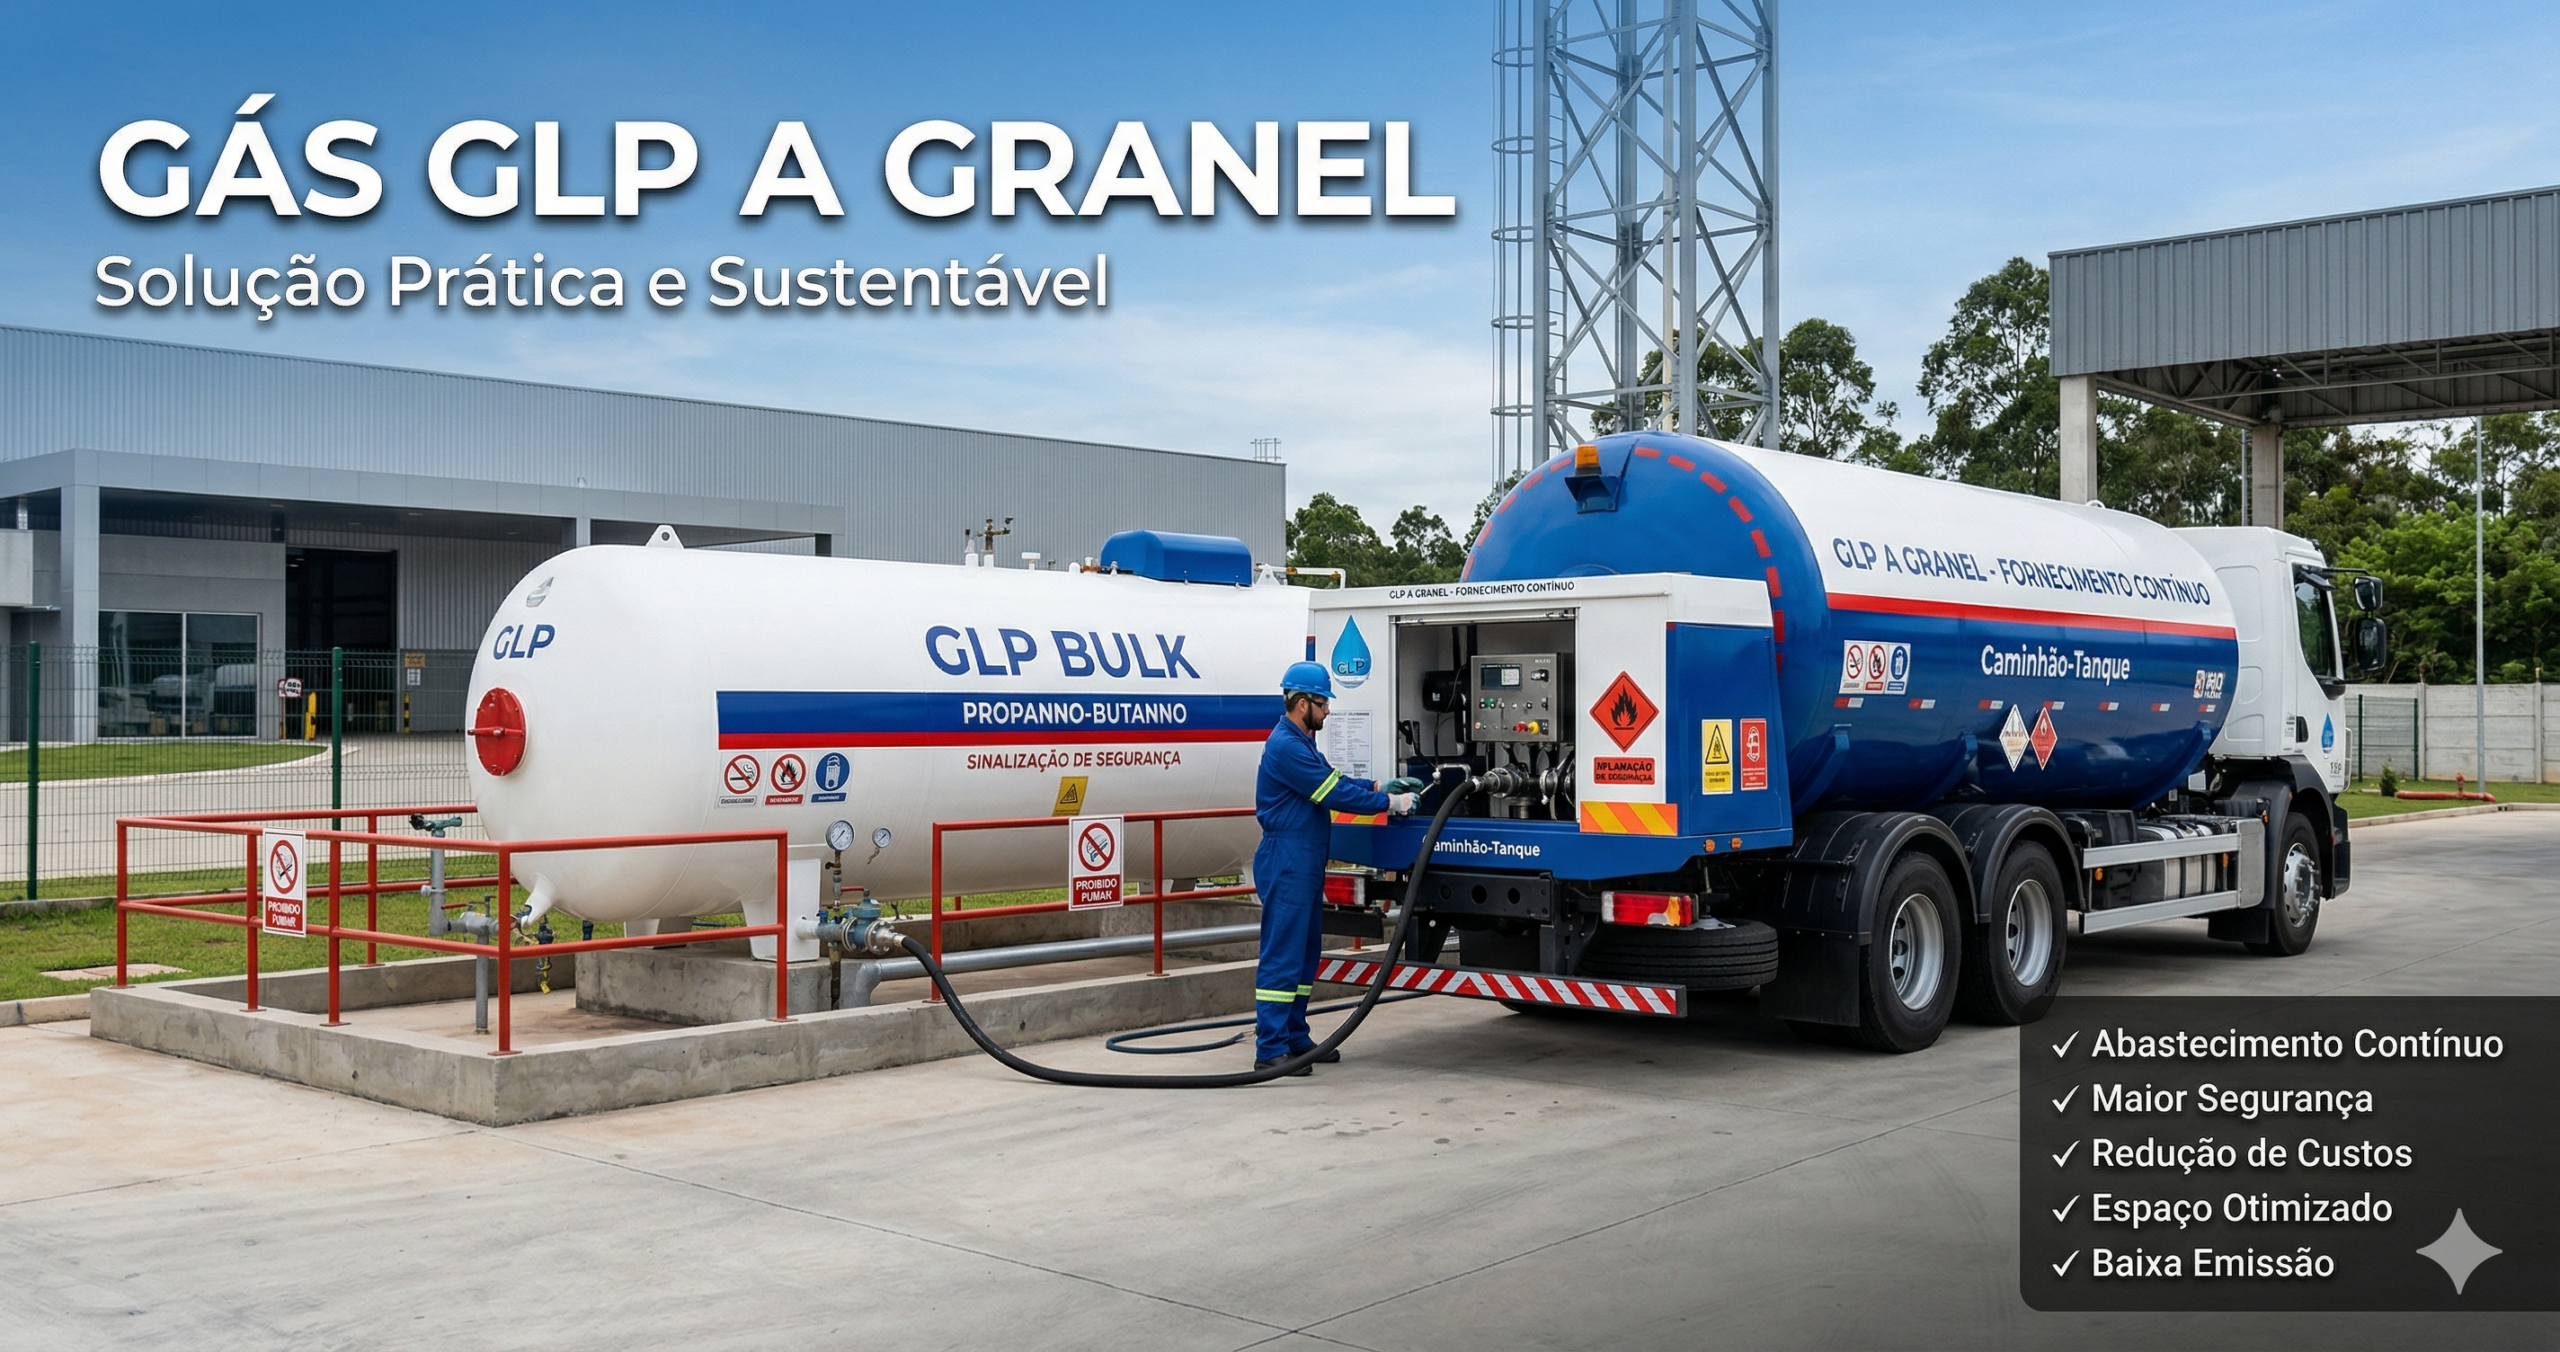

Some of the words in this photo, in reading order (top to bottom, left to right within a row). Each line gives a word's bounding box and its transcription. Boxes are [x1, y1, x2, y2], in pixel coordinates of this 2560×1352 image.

[1832, 537, 1877, 571] GLP
[1884, 544, 1903, 574] A
[1902, 546, 1988, 582] GRANEL
[1996, 557, 2133, 598] FORNECIMENTO
[2133, 573, 2211, 606] CONTÍNUO
[1407, 590, 1414, 599] A
[1415, 588, 1449, 599] GRANEL
[1455, 584, 1525, 596] FORNECIMENTO
[1526, 580, 1575, 593] CONTÍNUO
[493, 624, 556, 660] GLP
[925, 625, 1038, 676] GLP
[1050, 630, 1202, 679] BULK
[1981, 643, 2131, 687] Caminhão-Tanque
[962, 701, 1187, 726] PROPANNO-BUTANNO
[966, 748, 1070, 773] SINALIZAÇÃO
[1073, 752, 1092, 768] DE
[1096, 750, 1182, 771] SEGURANÇA
[1075, 877, 1118, 891] PROIBIDO
